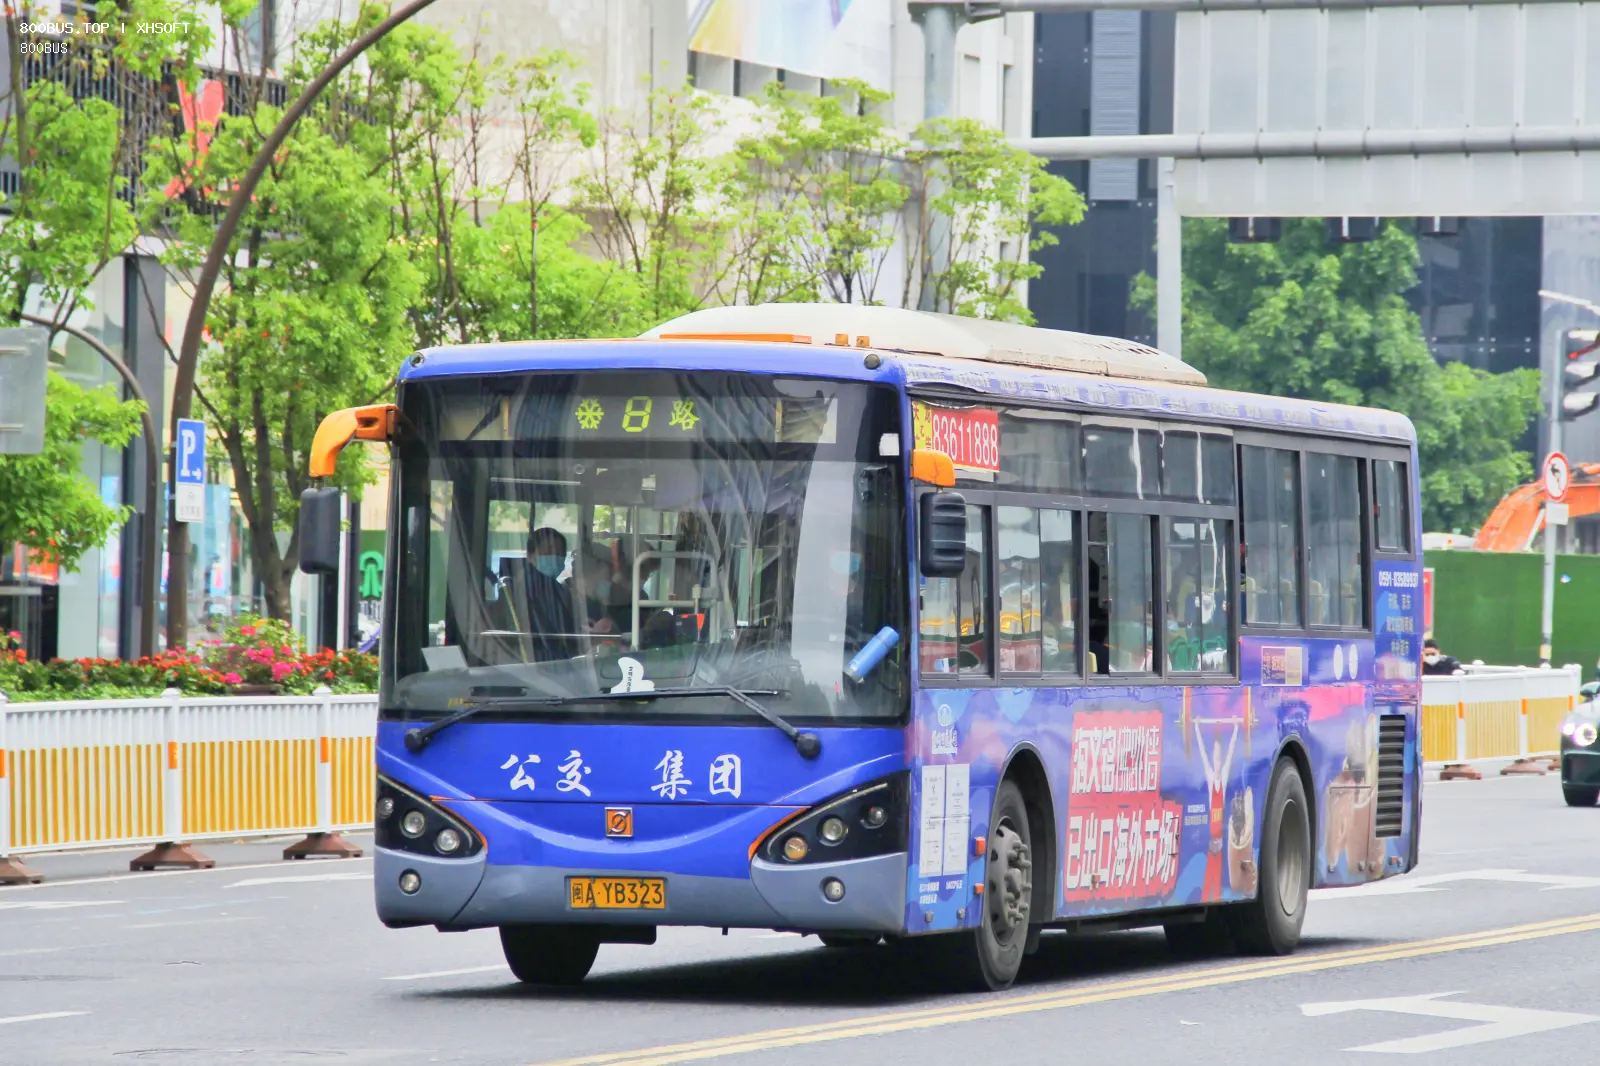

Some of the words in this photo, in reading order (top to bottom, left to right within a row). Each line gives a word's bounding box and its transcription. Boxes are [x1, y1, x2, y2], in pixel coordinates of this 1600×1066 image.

[180, 429, 196, 477] P
[932, 413, 999, 467] 83611888
[500, 750, 592, 797] 公交
[650, 750, 742, 800] 集团
